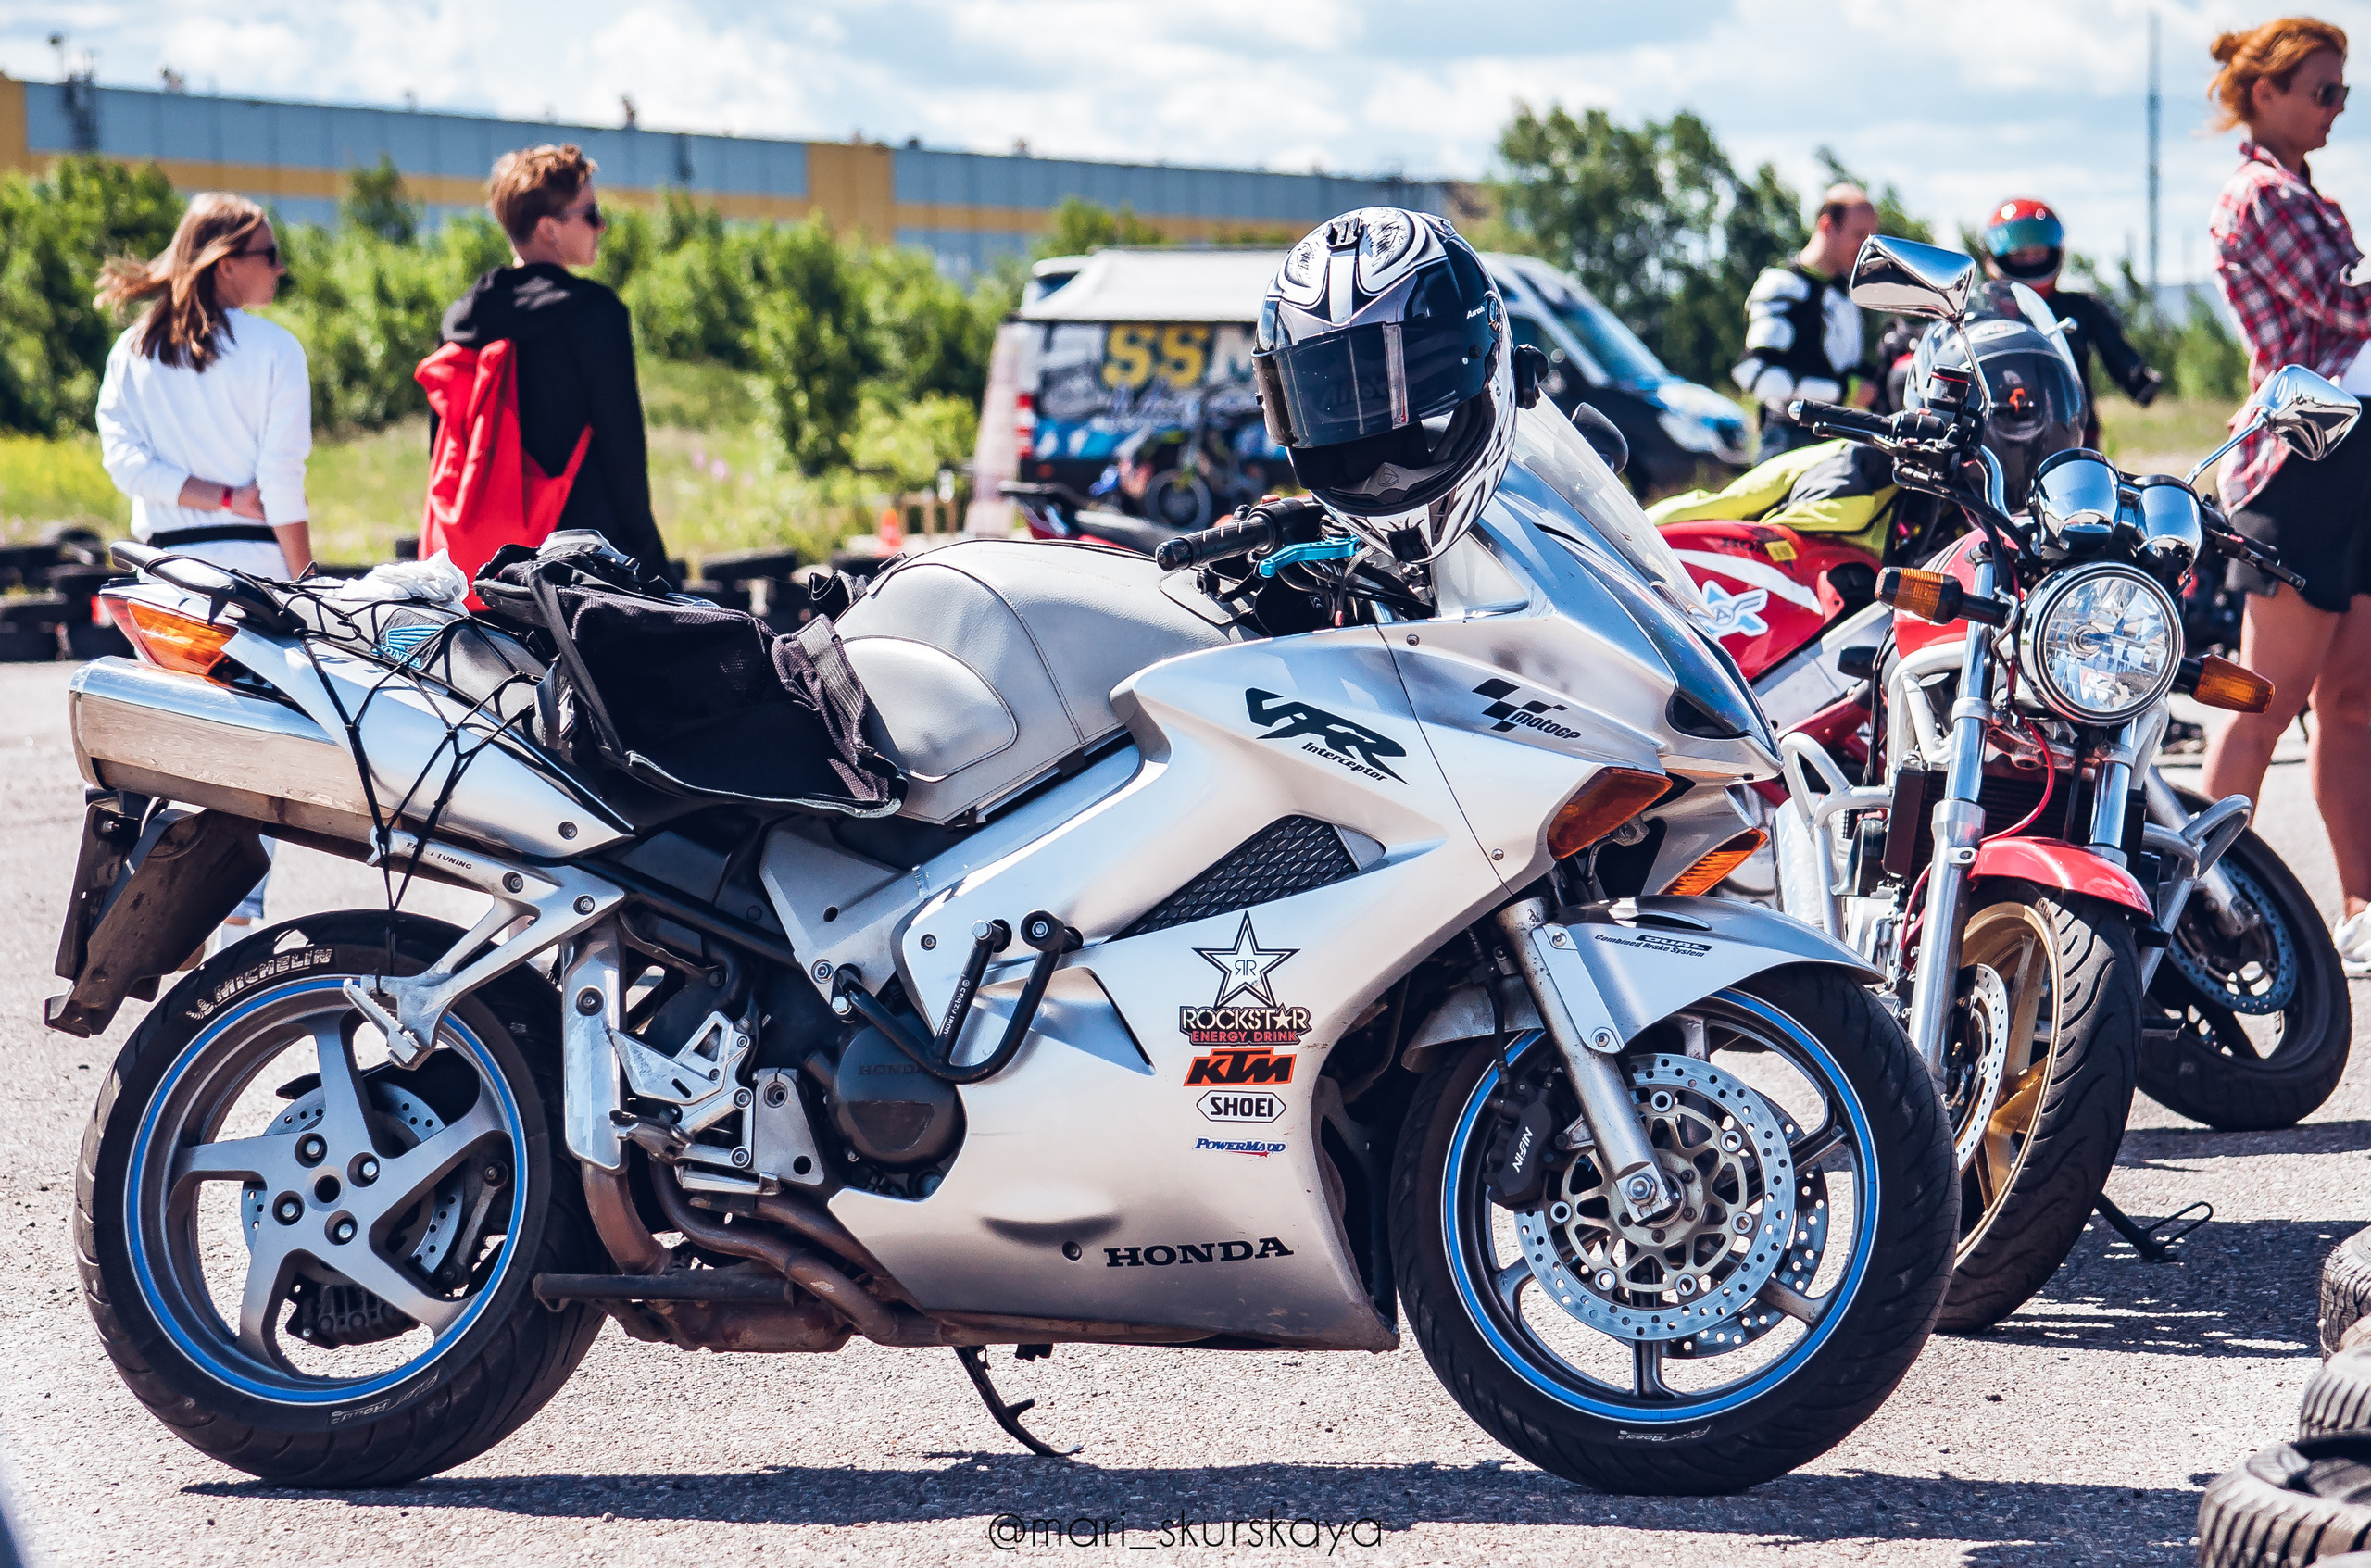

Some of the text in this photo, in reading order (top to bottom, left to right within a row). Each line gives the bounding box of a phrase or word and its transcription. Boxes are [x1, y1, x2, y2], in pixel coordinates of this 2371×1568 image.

[1245, 687, 1410, 785] VFR
[1301, 741, 1388, 782] Interceptor
[437, 853, 472, 870] TUNING
[1594, 934, 1706, 958] Combined Brake System
[213, 948, 333, 1003] MICHELIN
[1192, 1031, 1298, 1042] ENERGY DRINK
[1187, 1049, 1293, 1085] KTM
[1210, 1097, 1273, 1118] SHOEI
[1512, 1126, 1534, 1173] NISSIN
[1103, 1236, 1295, 1268] HONDA
